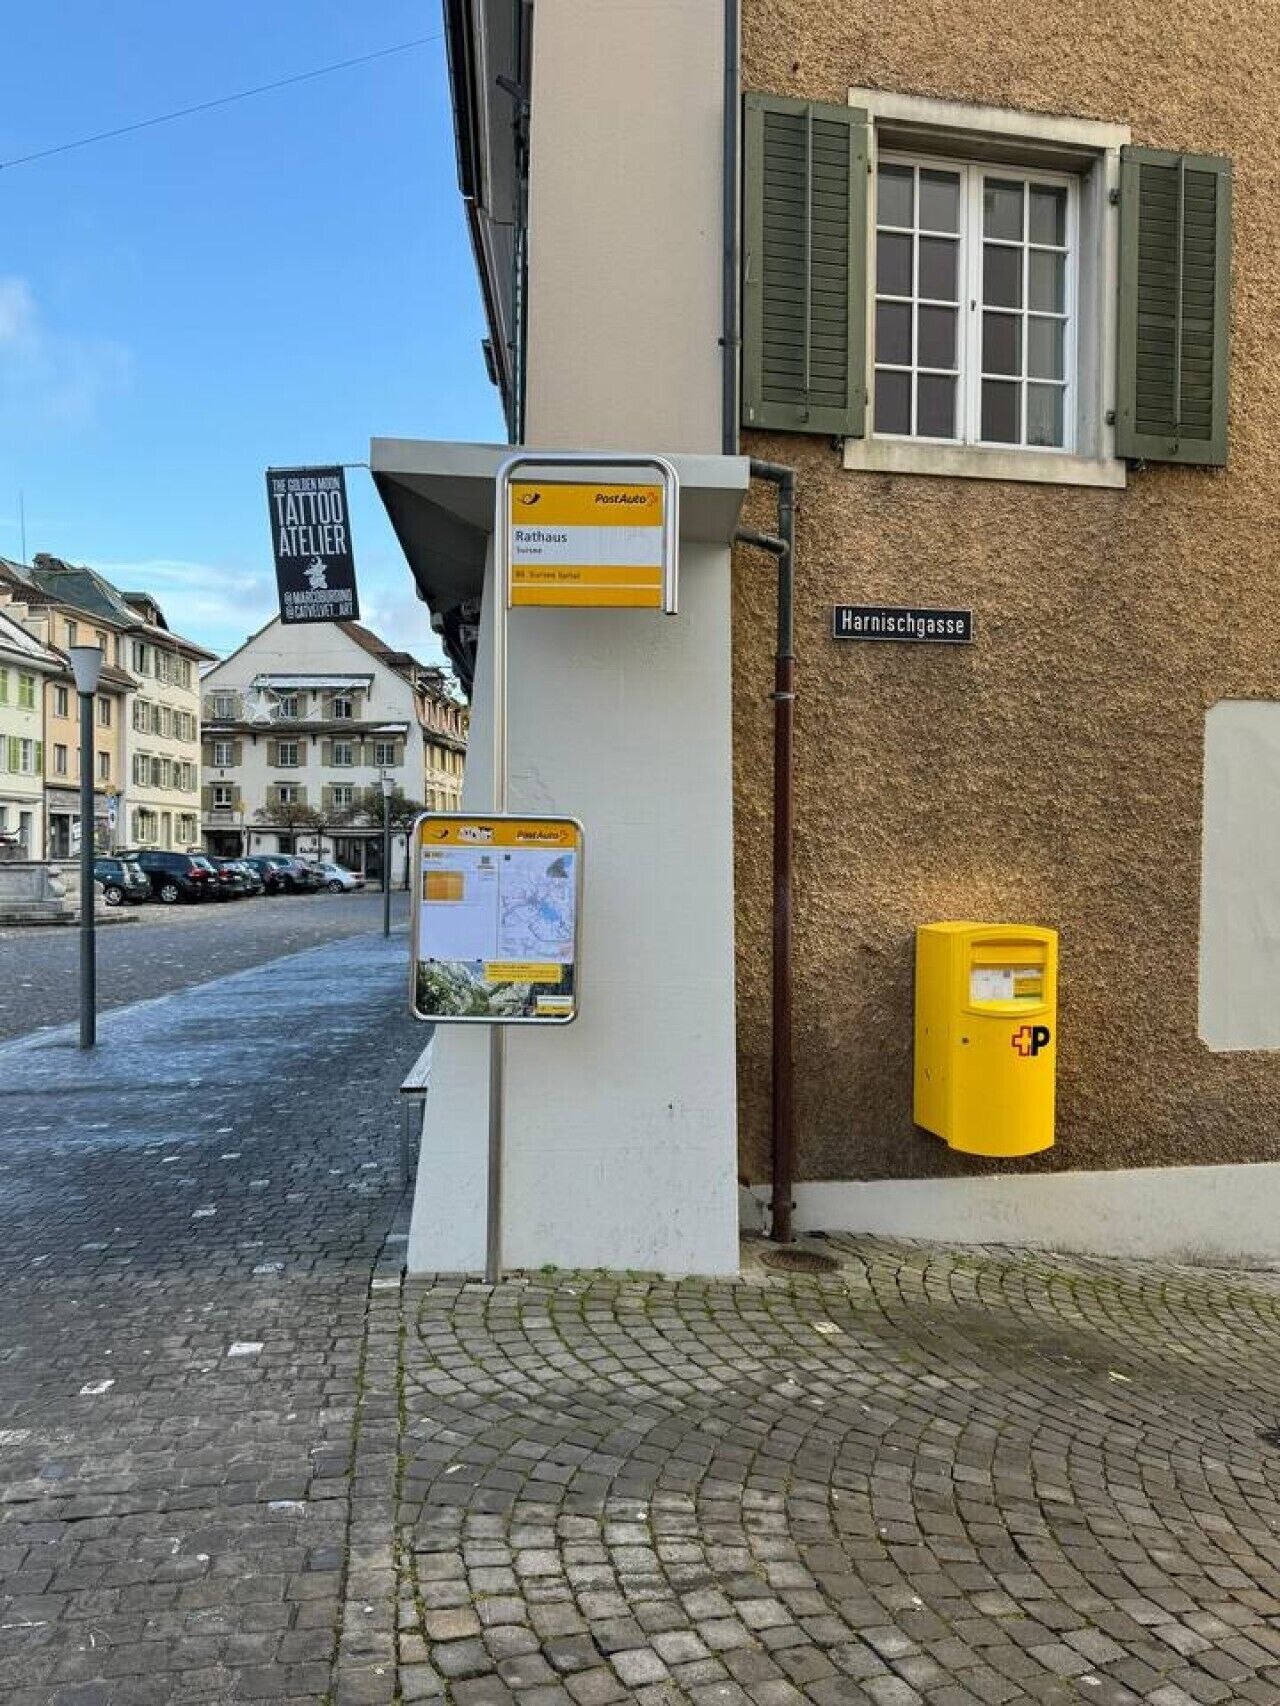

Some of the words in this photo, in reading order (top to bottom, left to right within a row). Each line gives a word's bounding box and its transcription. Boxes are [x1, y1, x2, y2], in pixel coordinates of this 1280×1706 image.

[273, 491, 344, 526] TATTOO
[595, 493, 647, 504] PostAuto
[279, 524, 347, 557] ATELIER
[515, 531, 568, 543] Rathaus
[841, 609, 965, 638] Harnischgasse
